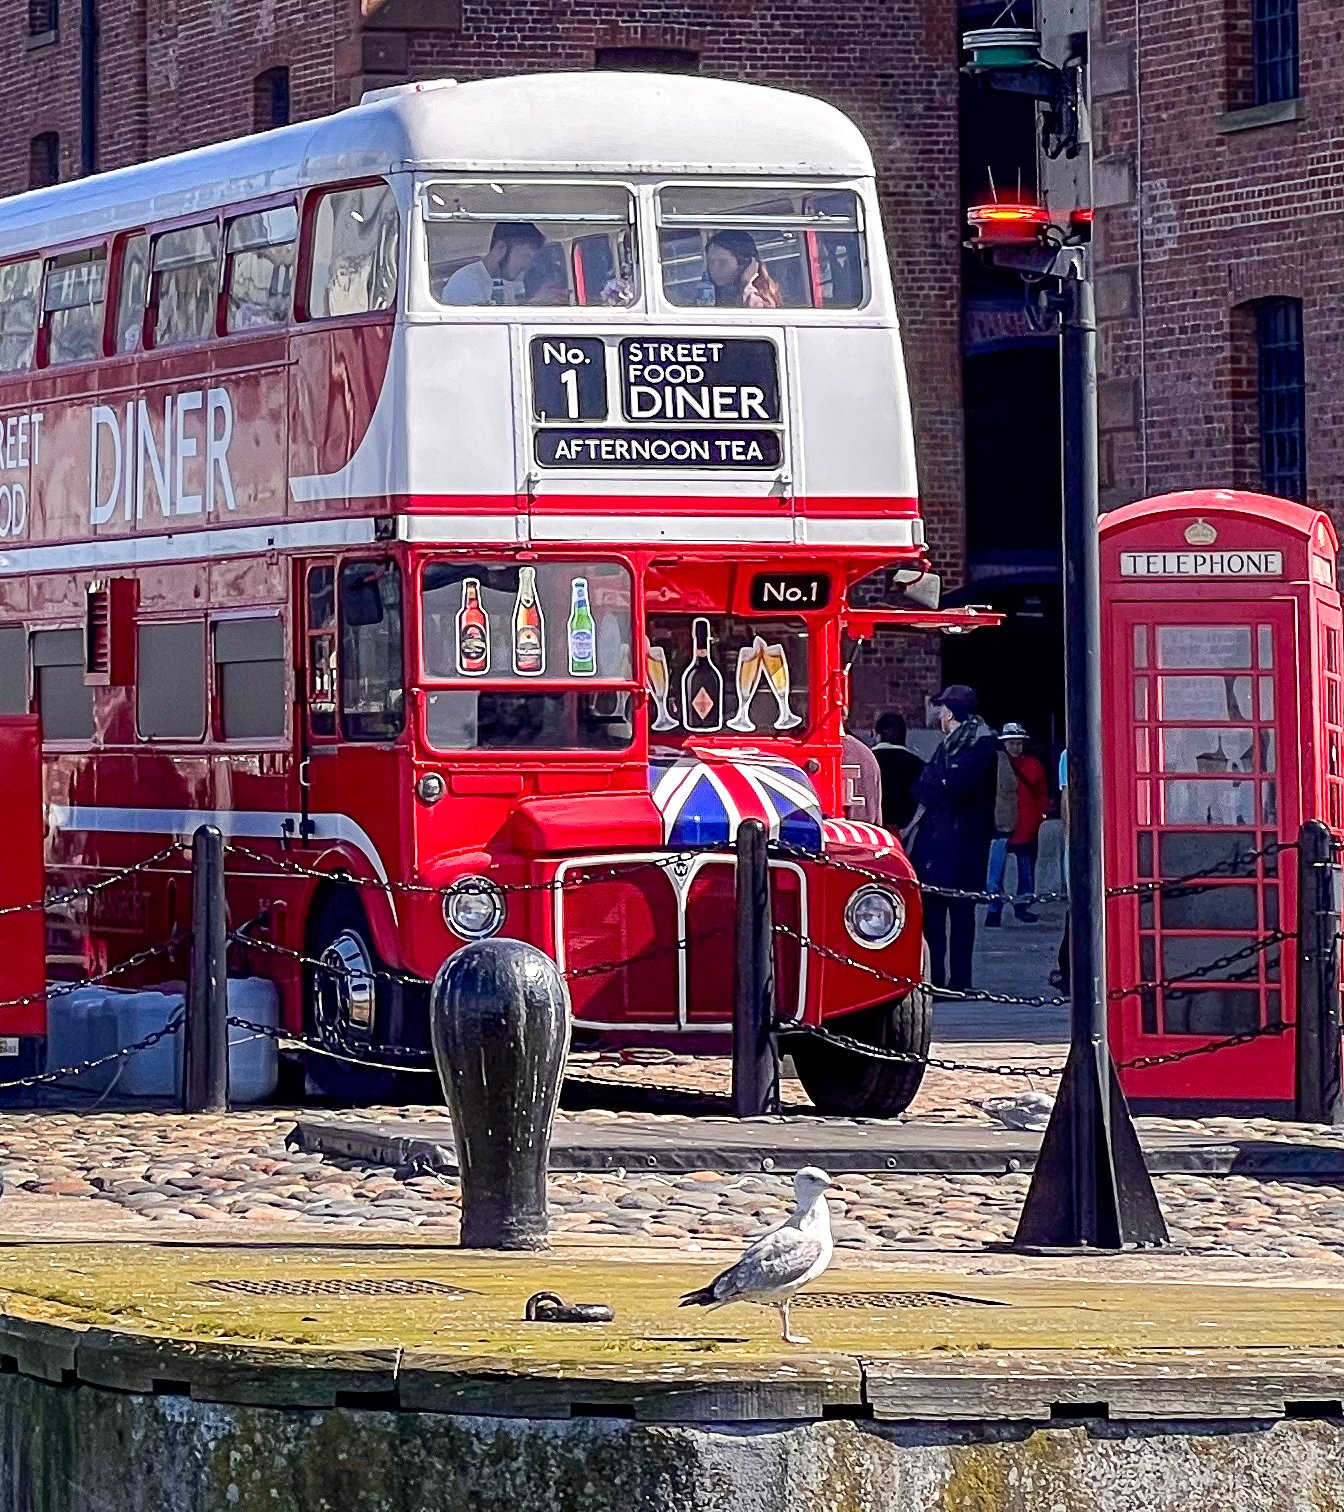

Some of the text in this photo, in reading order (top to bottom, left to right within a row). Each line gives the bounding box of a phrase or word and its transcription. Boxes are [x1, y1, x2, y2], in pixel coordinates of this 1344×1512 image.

[542, 342, 592, 365] No.
[628, 343, 724, 363] STREET
[628, 364, 705, 384] FOOD
[561, 369, 580, 419] 1
[629, 385, 770, 419] DINER
[90, 387, 236, 525] DINER
[554, 439, 764, 461] AFTERNOON TEA
[1127, 553, 1277, 574] TELEPHONE
[763, 582, 818, 602] No.1
